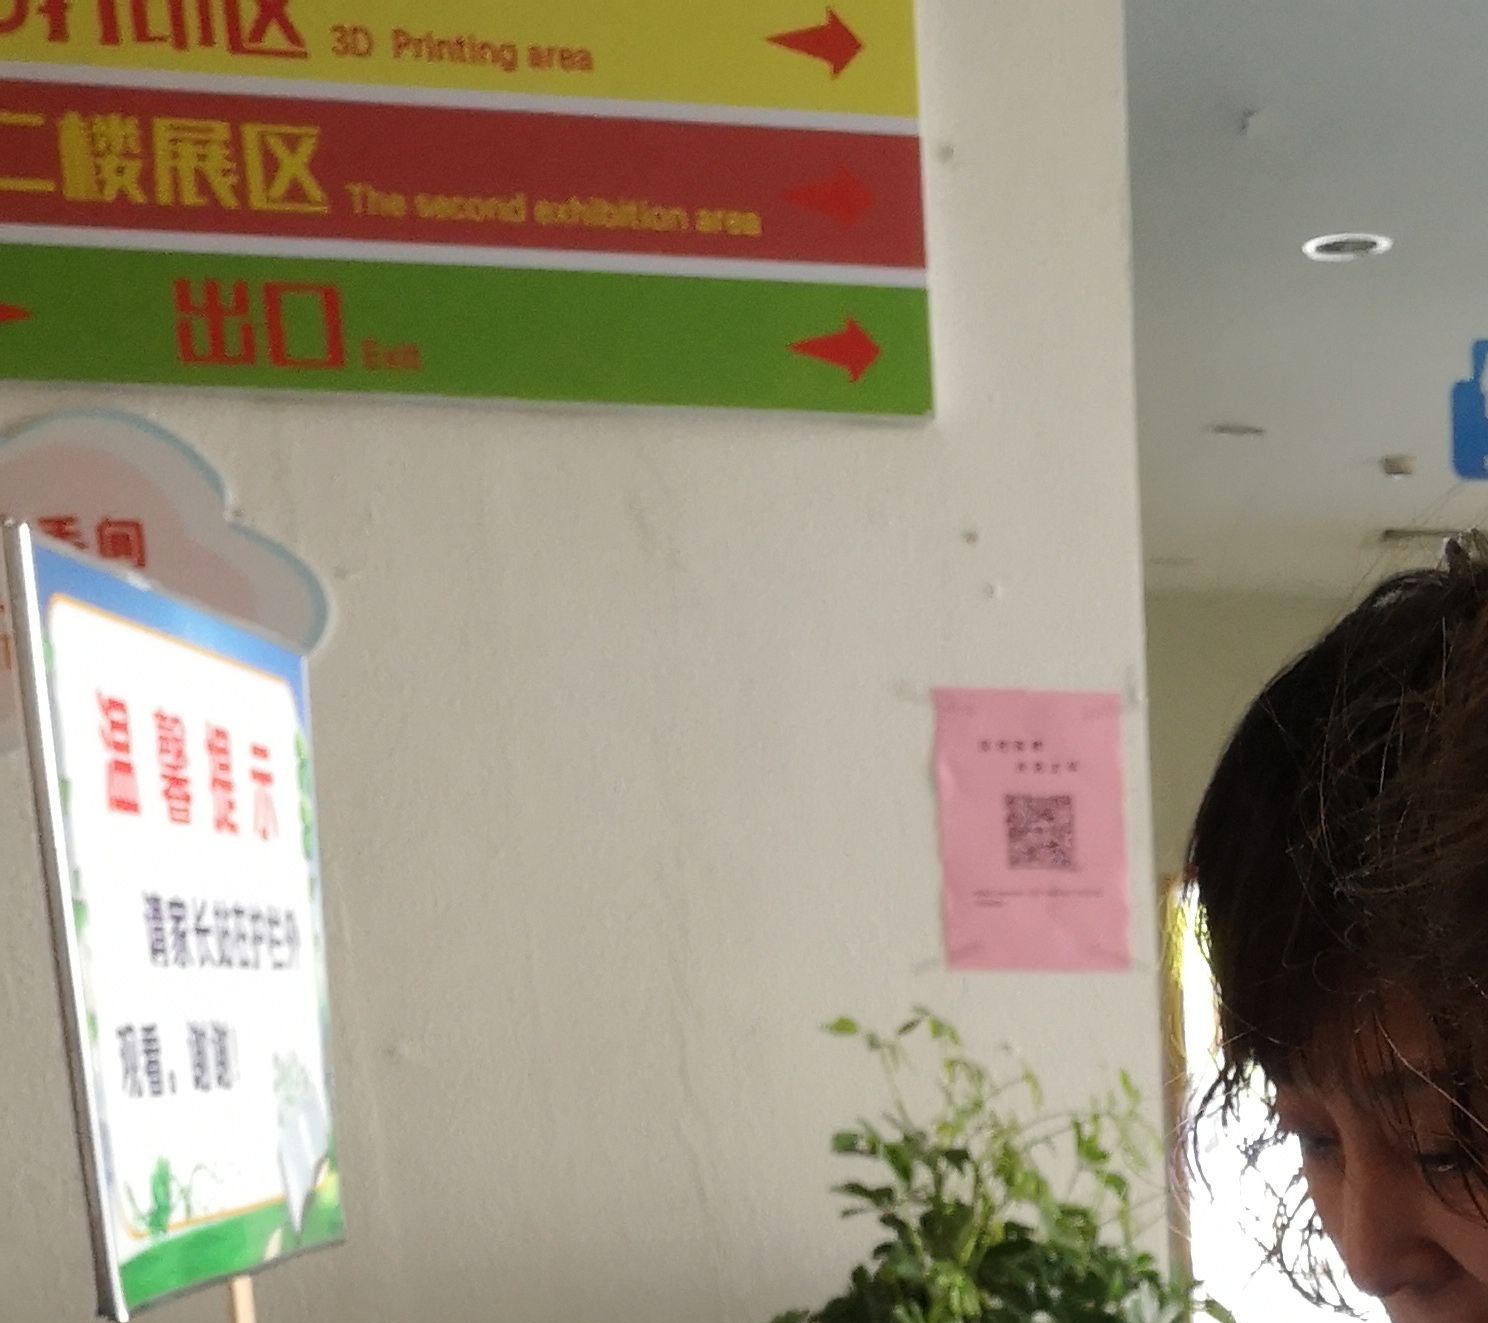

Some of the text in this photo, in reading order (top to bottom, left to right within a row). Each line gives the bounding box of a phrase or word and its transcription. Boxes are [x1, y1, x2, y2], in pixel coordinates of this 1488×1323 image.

[331, 25, 594, 71] 3D Printing area
[0, 111, 328, 213] 二楼展区
[346, 183, 762, 236] The second exhibition area
[173, 279, 346, 368] 出口
[99, 692, 279, 839] 温馨提示
